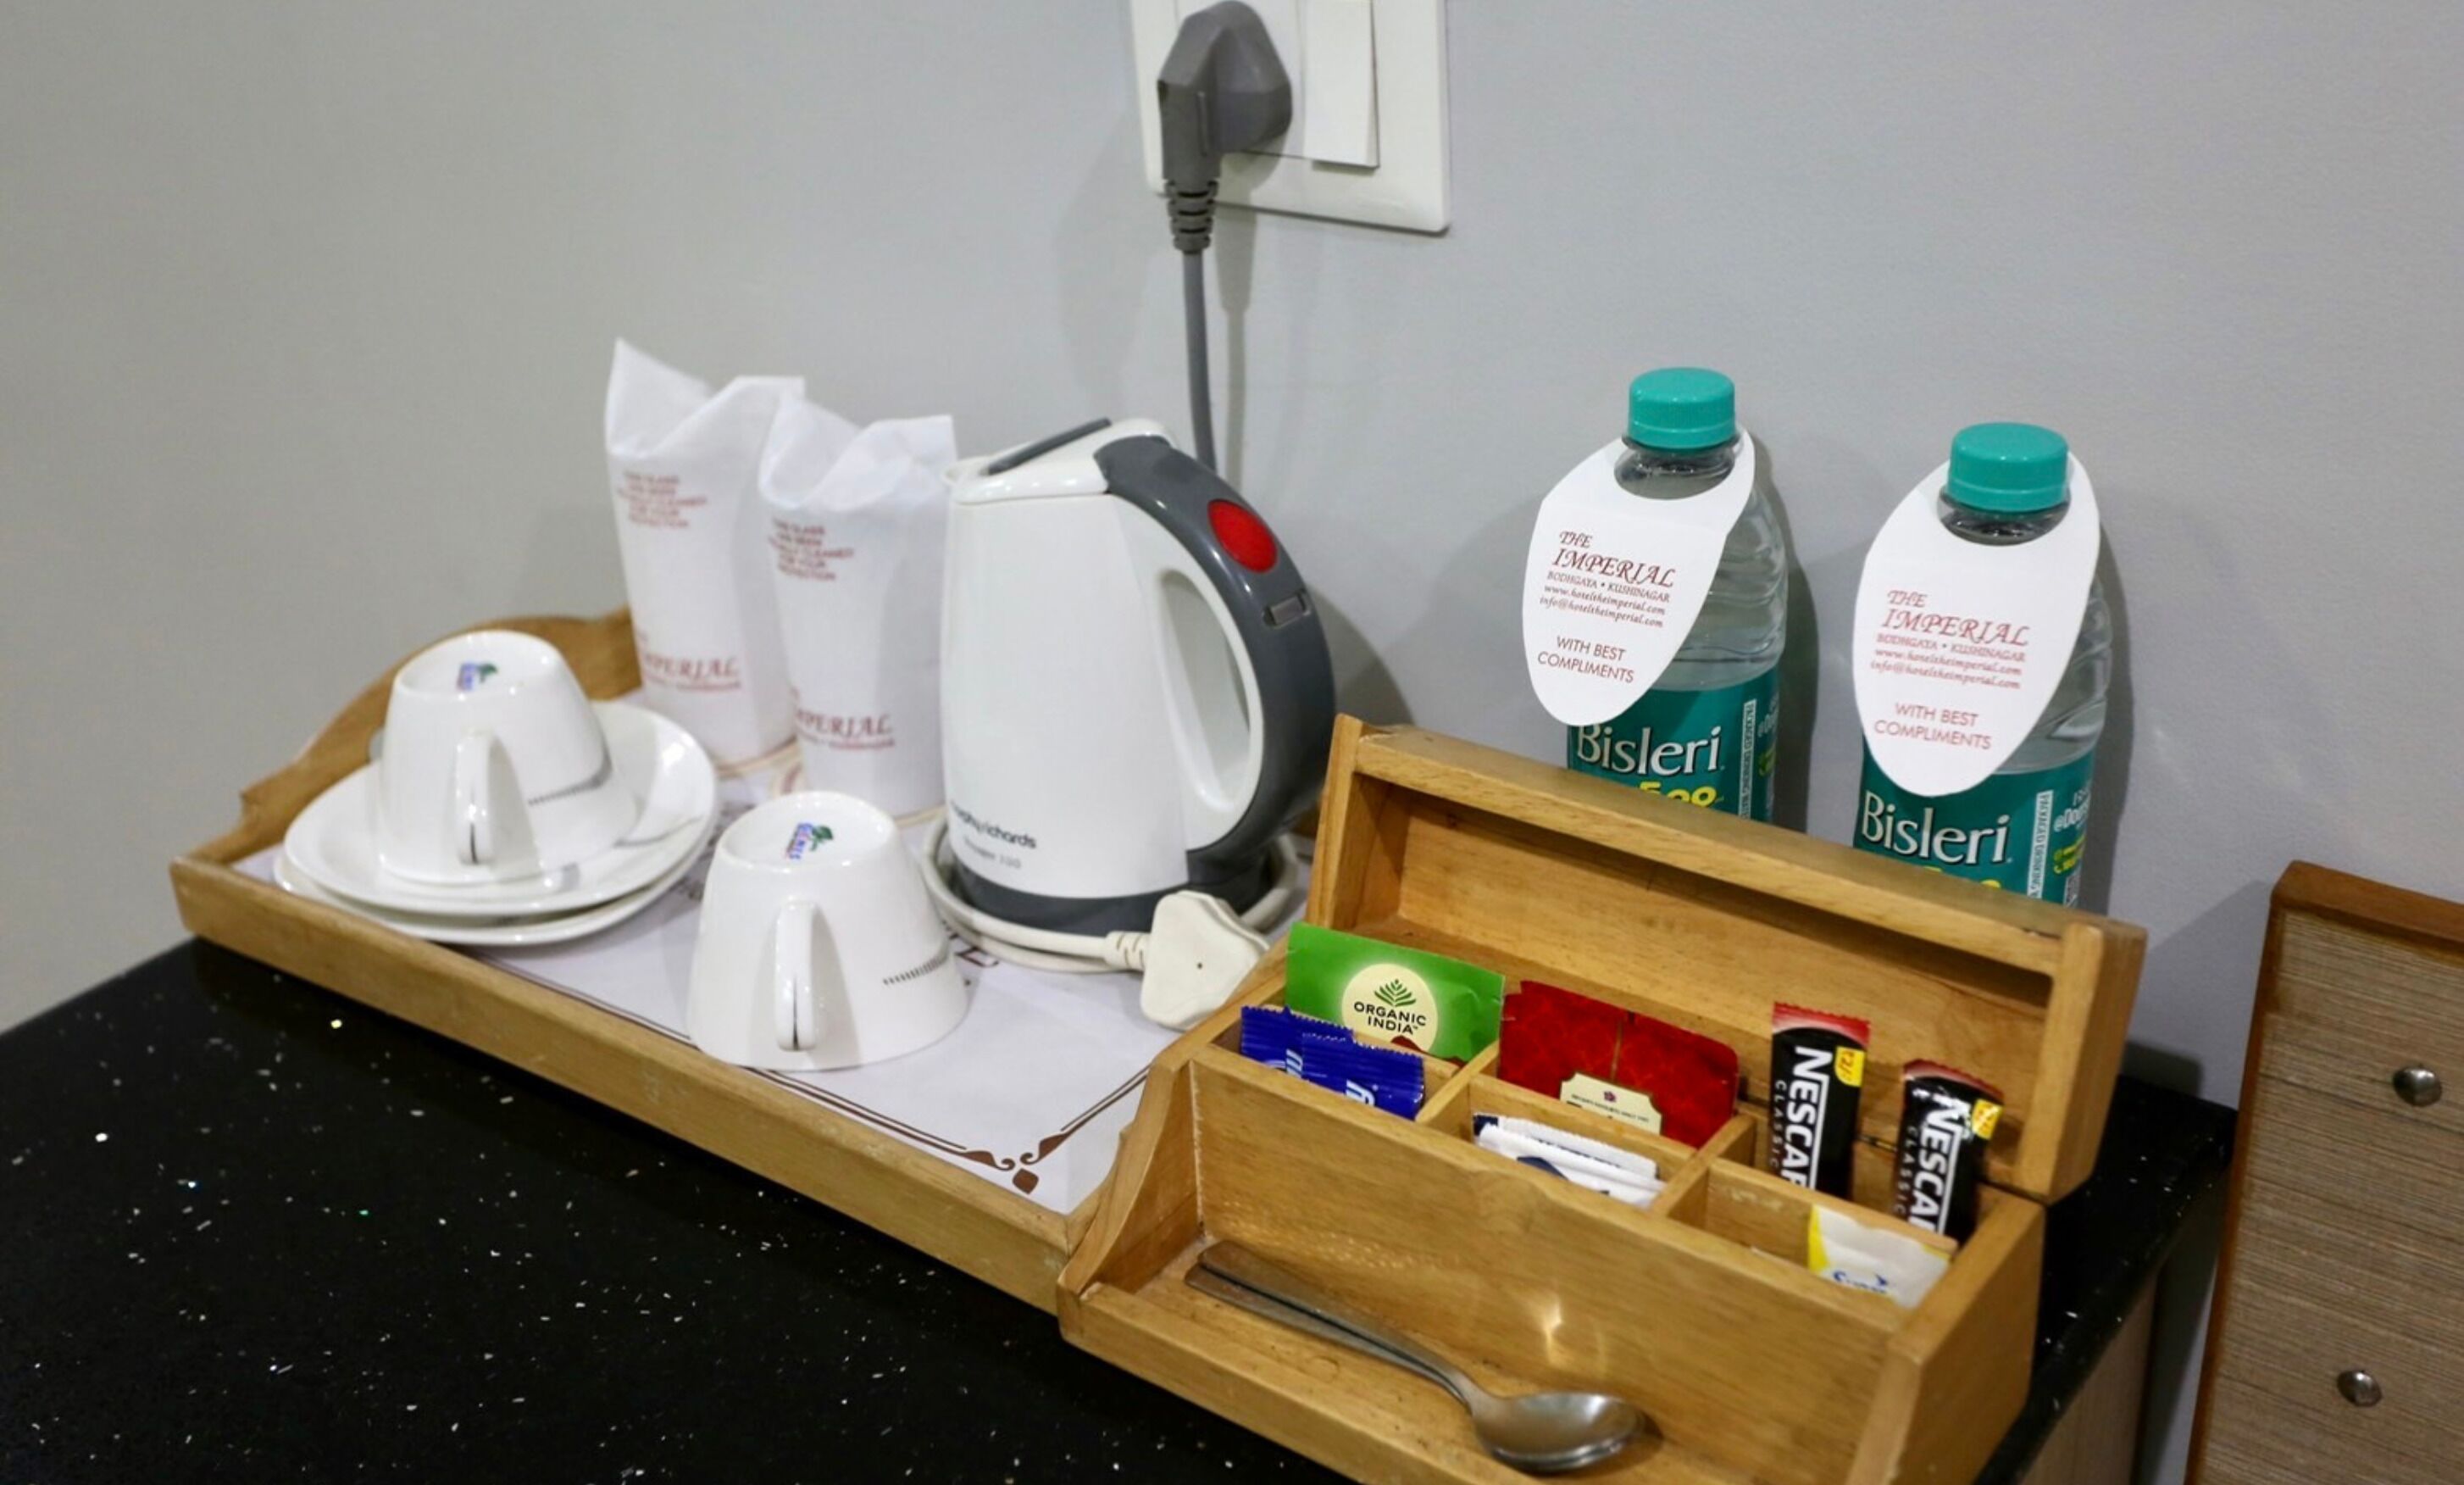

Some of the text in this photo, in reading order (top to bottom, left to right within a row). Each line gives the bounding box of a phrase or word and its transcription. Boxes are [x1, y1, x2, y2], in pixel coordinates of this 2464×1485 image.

[1559, 531, 1592, 549] THE
[1552, 548, 1676, 588] IMPERIAL
[1887, 590, 1927, 609] THE
[1882, 609, 2030, 647] IMPERIAL
[1557, 636, 1627, 662] WITH BEST
[1537, 651, 1635, 684] COMPLIMENTS
[1895, 703, 1979, 727] WITH BEST
[1577, 725, 1721, 777] Bisleri
[1873, 720, 1993, 751] COMPLIMENTS
[1862, 790, 2011, 865] Bisleri
[1354, 1001, 1427, 1026] ORGANIC
[1770, 1078, 1788, 1169] CLASSIC
[1780, 1046, 1833, 1190] NESCAF
